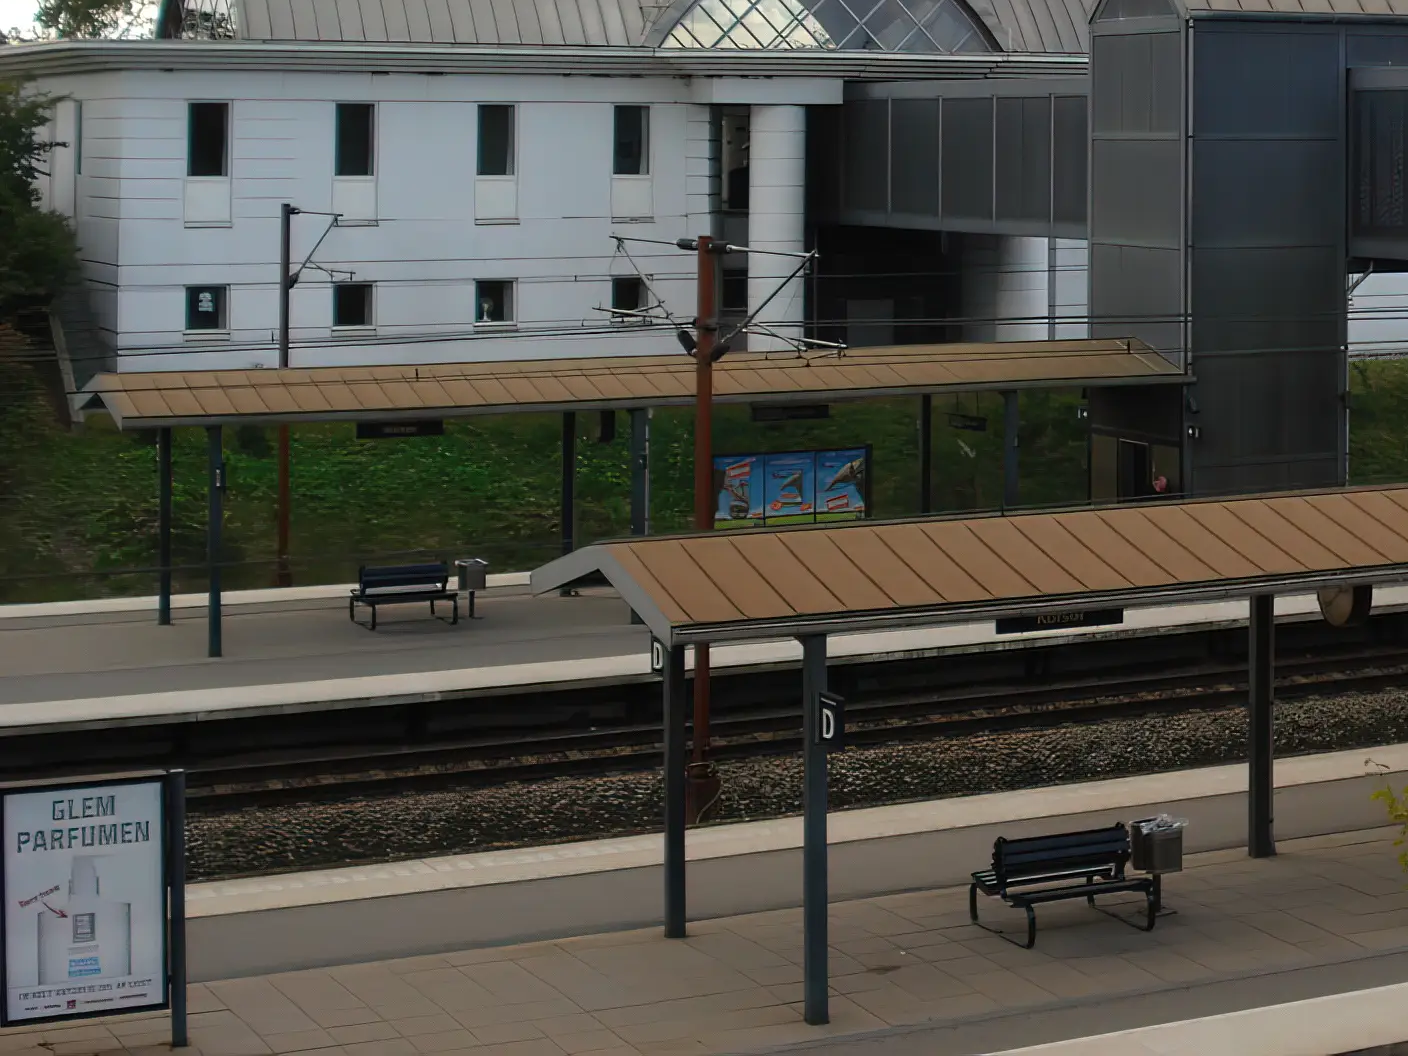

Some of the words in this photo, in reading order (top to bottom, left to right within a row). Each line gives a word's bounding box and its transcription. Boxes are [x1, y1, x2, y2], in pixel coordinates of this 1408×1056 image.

[652, 641, 664, 669] D
[821, 707, 835, 739] D
[52, 795, 116, 821] GLEM
[17, 821, 150, 853] PARFUMEN
